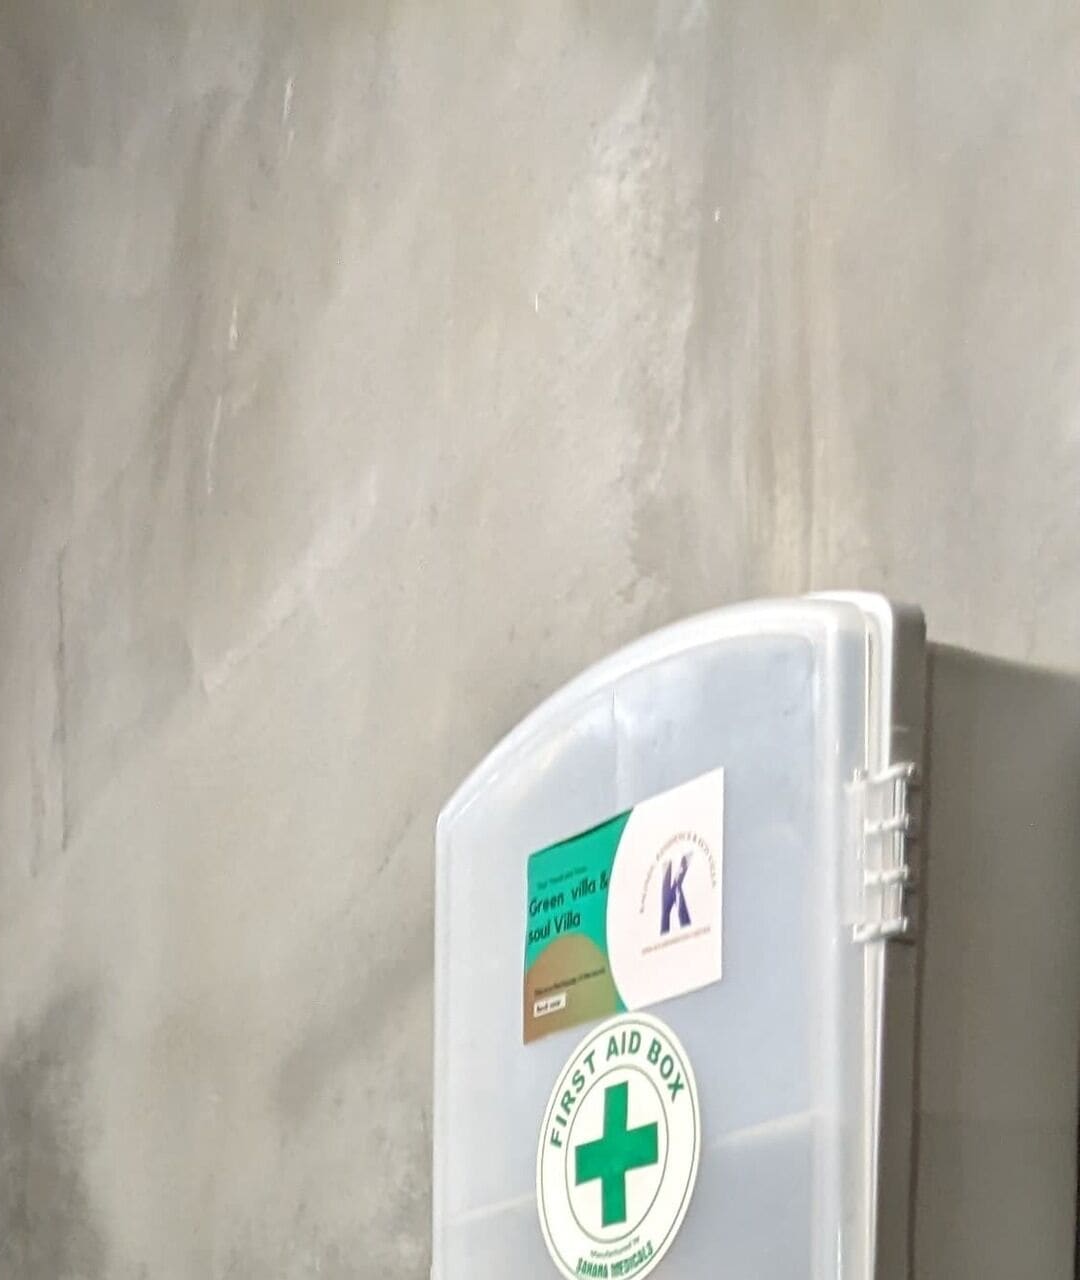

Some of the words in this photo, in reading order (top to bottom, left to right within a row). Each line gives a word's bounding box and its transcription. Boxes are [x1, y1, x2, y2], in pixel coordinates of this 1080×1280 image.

[529, 892, 564, 916] Green
[571, 878, 595, 901] villa
[661, 855, 691, 936] K
[528, 919, 551, 944] soul
[554, 911, 580, 932] Villa
[550, 1050, 596, 1148] FIRST
[606, 1031, 641, 1061] AID
[647, 1039, 685, 1102] BOX
[611, 1241, 654, 1279] MEDICALS
